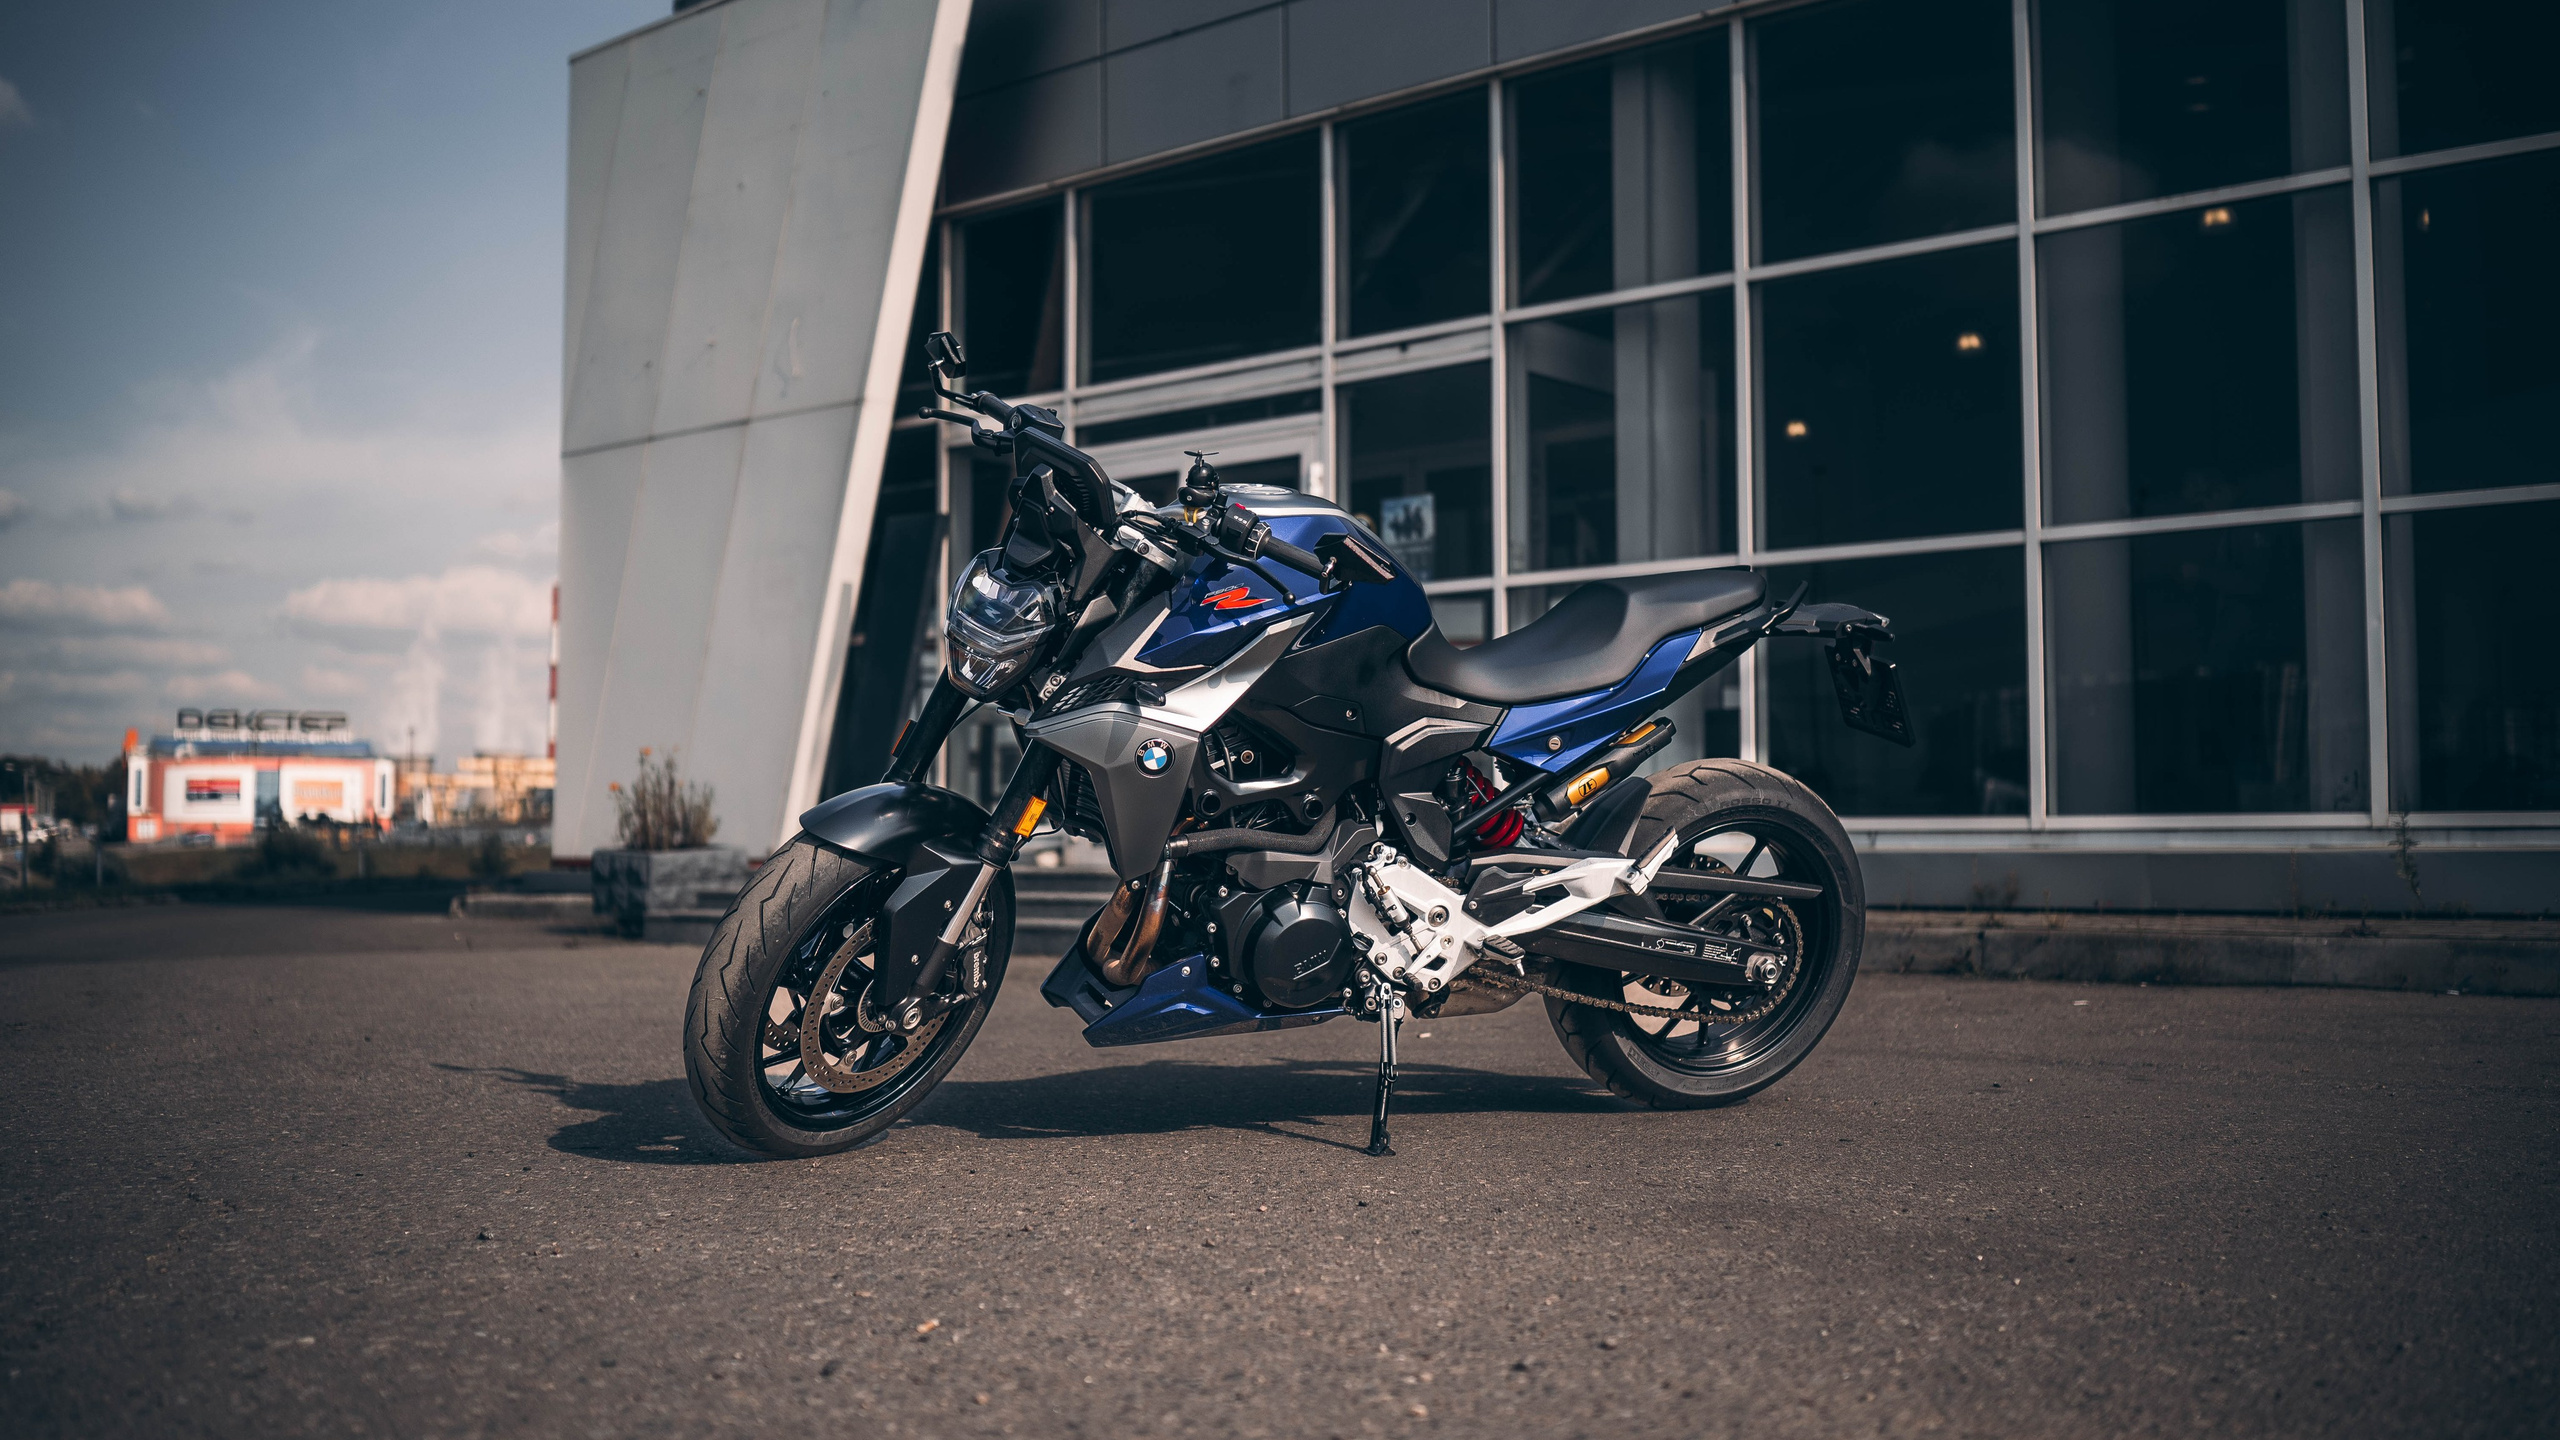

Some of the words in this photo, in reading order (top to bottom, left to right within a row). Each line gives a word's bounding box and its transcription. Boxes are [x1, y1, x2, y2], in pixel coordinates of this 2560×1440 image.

[1137, 740, 1169, 757] BMW
[1578, 779, 1597, 796] ZF
[973, 950, 982, 989] brembo
